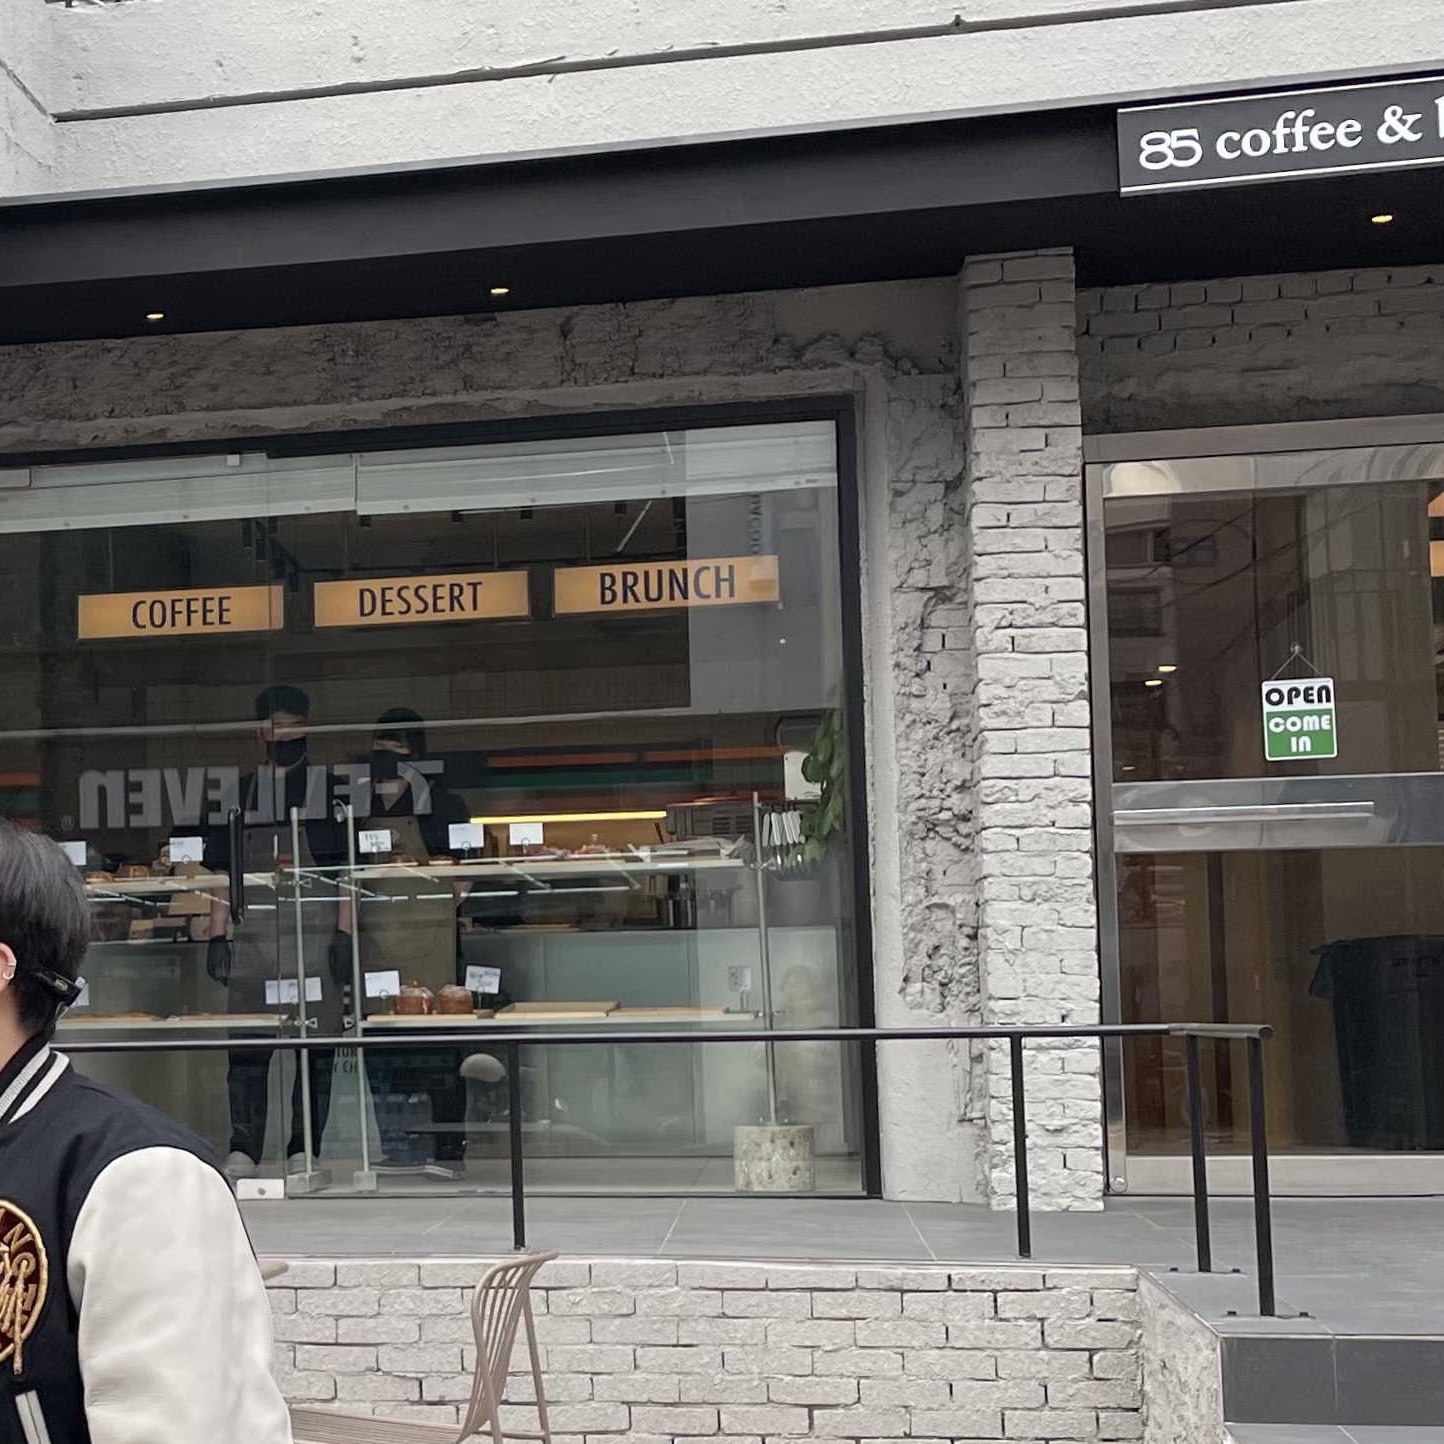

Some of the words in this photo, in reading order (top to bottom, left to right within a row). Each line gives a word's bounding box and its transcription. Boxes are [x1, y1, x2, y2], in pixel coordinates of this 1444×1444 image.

[1138, 128, 1203, 170] 85
[1215, 108, 1363, 160] coffee
[1376, 104, 1424, 145] &
[358, 580, 484, 618] DESSERT
[599, 564, 736, 606] BRUNCH
[131, 595, 233, 629] COFFEE
[1264, 684, 1332, 707] OPEN
[1268, 714, 1332, 733] COME
[1290, 735, 1312, 753] IN
